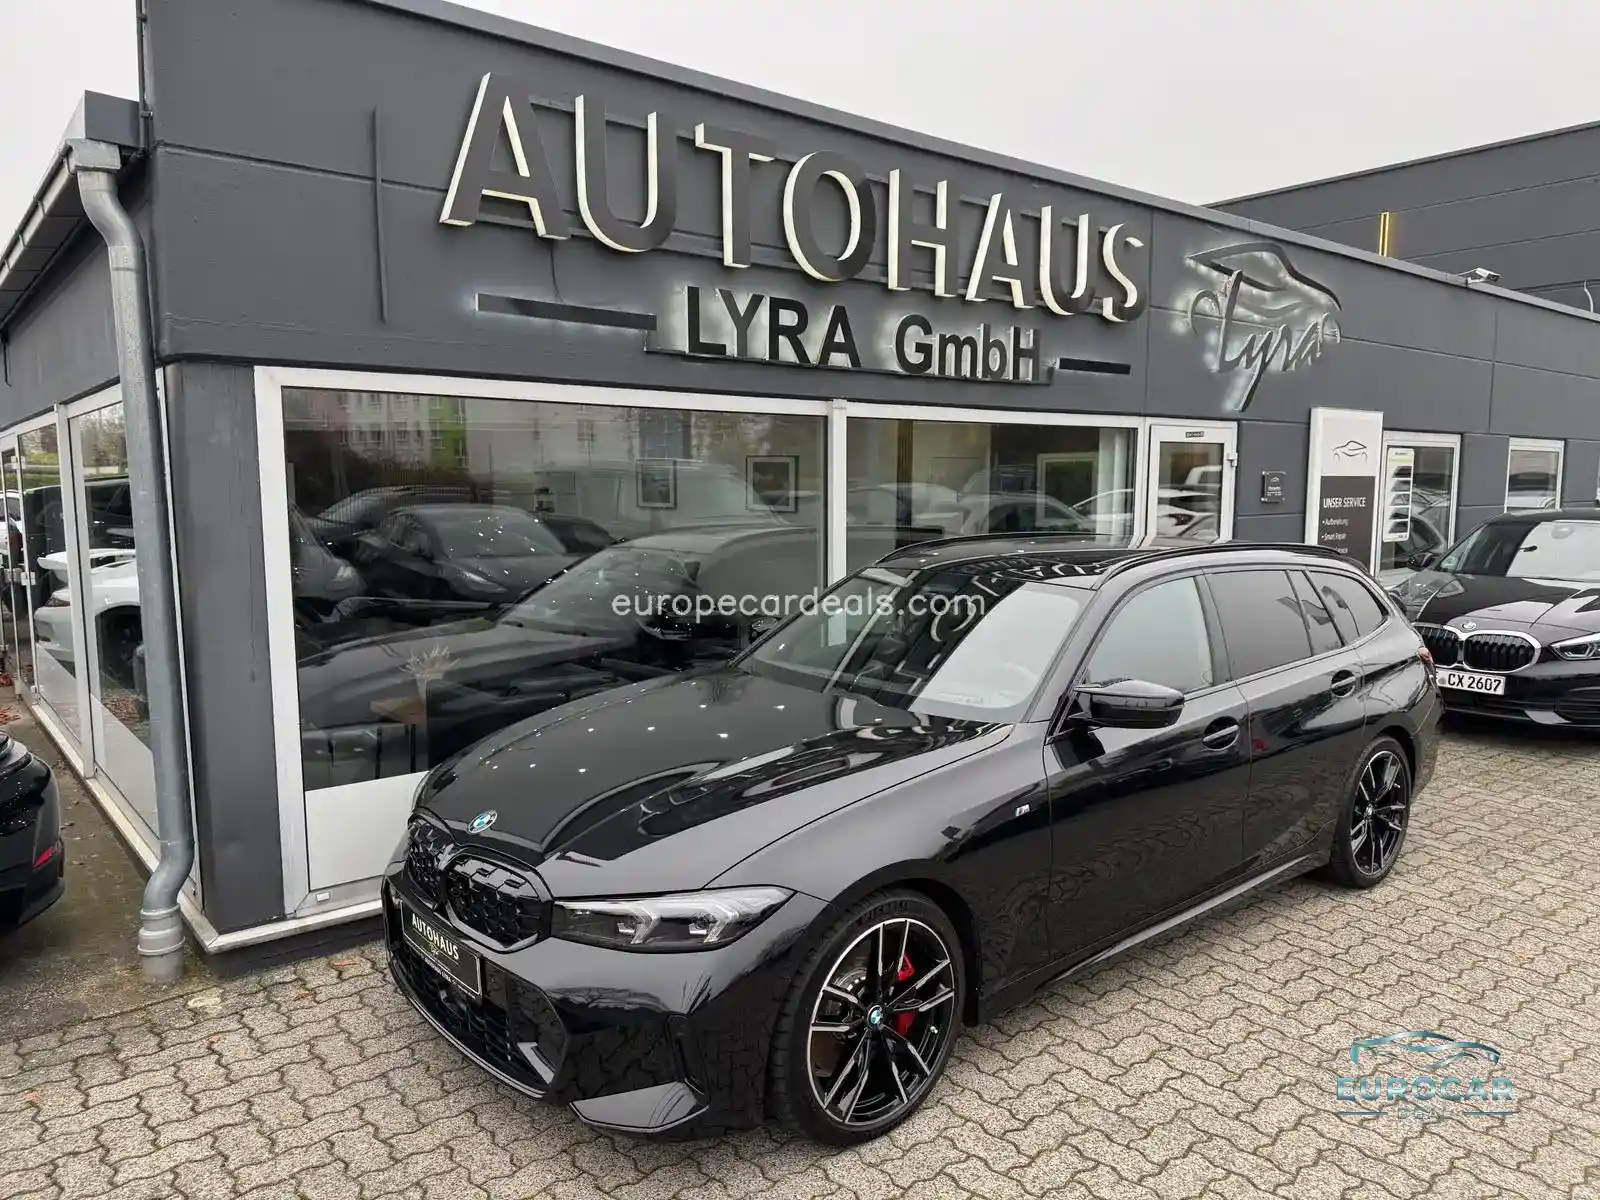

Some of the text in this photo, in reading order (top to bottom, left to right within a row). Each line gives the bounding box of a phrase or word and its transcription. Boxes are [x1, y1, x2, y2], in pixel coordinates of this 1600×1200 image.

[440, 72, 1147, 324] AUTOHAUS
[686, 285, 1041, 381] LYRA GmbH
[1323, 496, 1367, 508] UNSER SERVICE
[1447, 673, 1503, 693] CX 2607
[412, 912, 460, 961] AUTOHAUS
